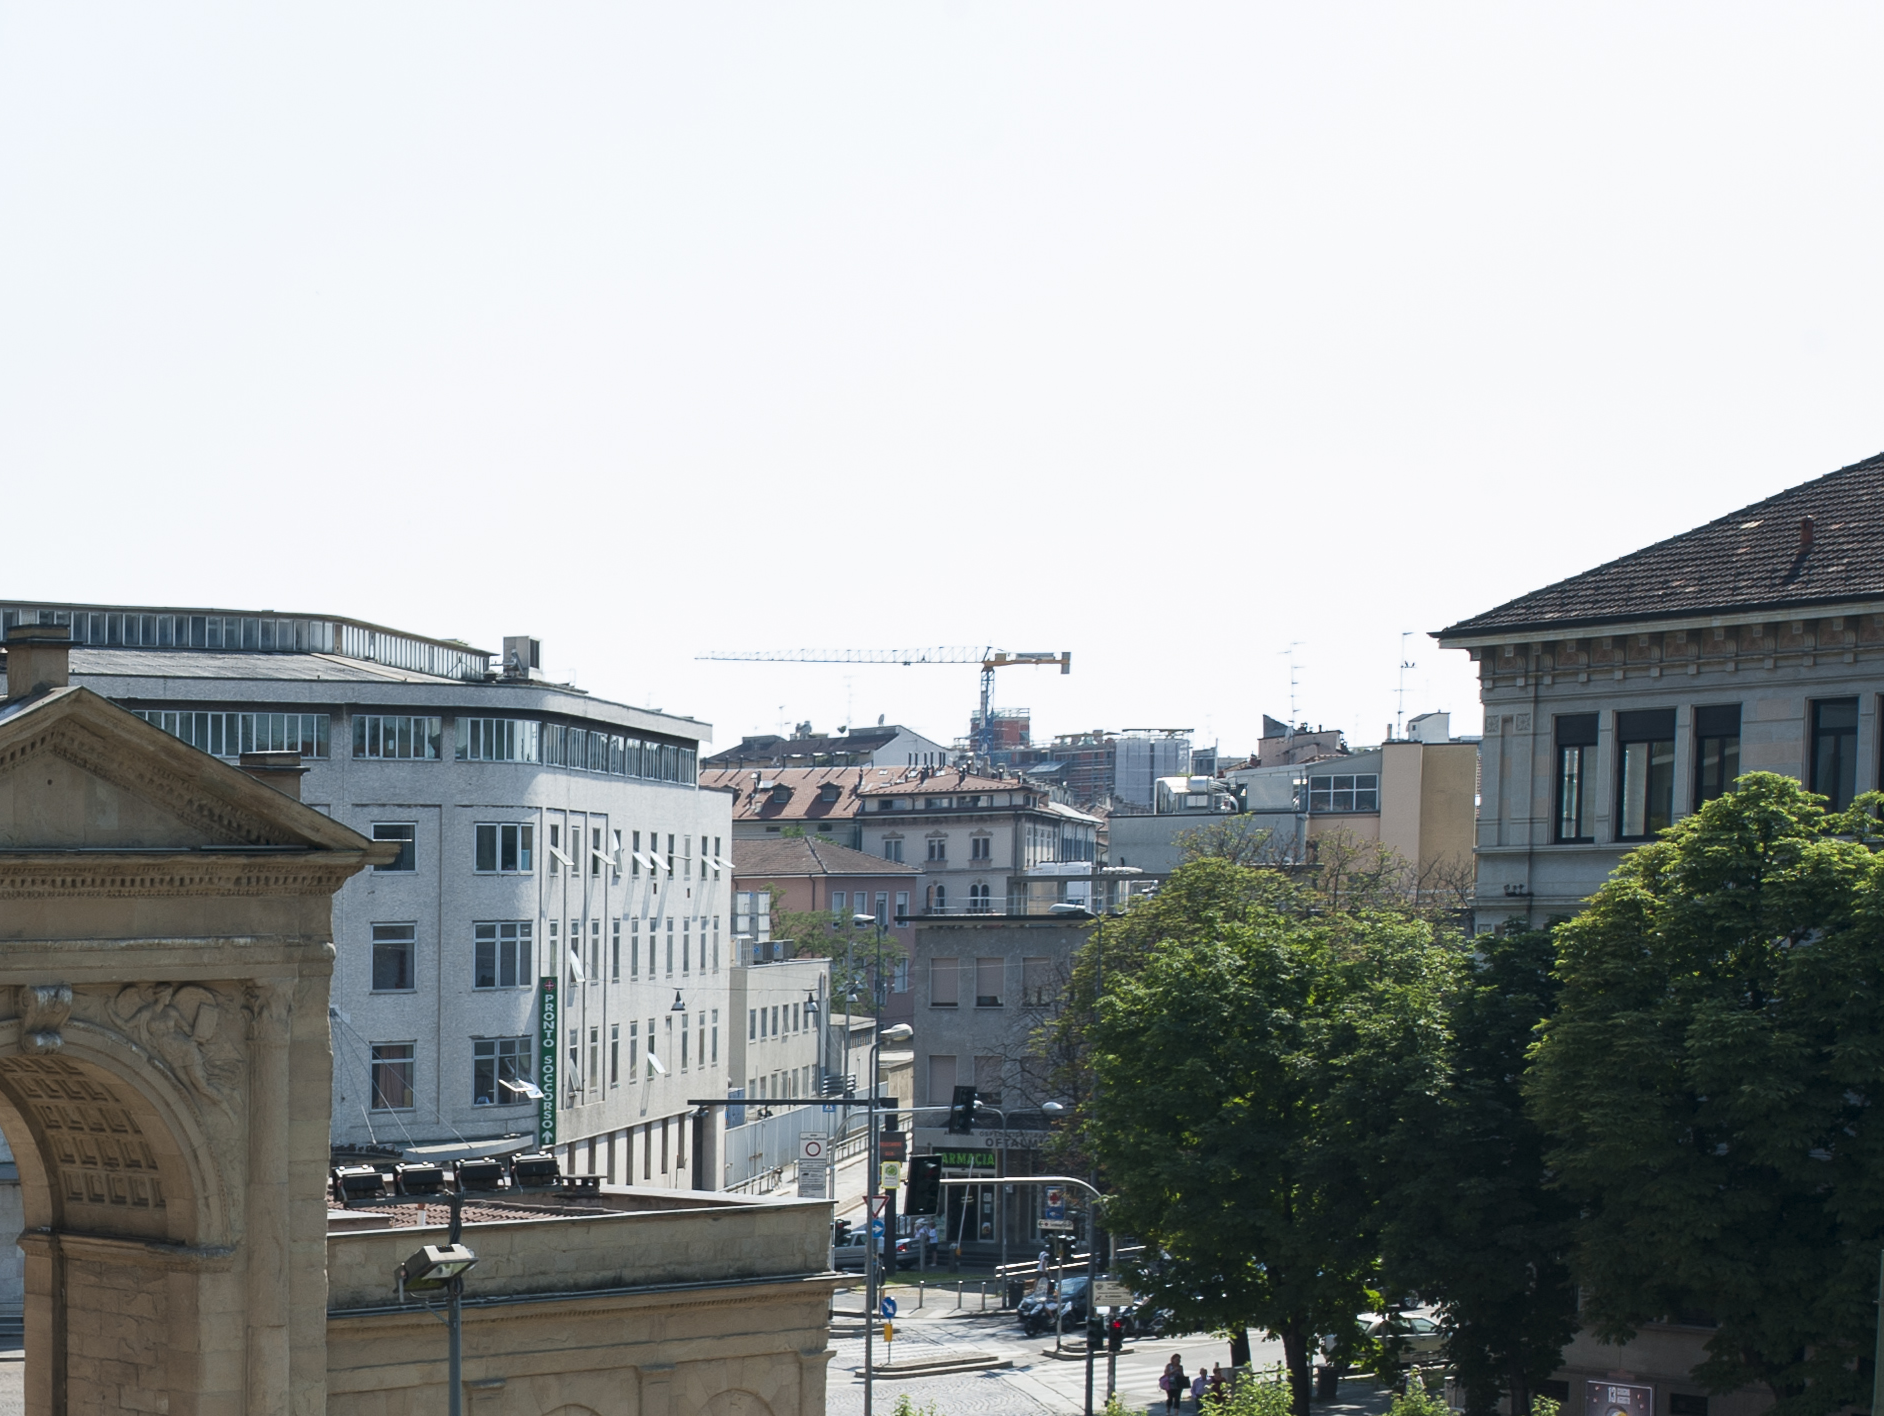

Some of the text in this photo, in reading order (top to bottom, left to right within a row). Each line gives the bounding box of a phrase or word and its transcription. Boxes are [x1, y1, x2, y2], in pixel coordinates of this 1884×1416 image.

[541, 994, 555, 1129] PRONTO SOCCORSO
[938, 1152, 995, 1166] ARMACIA
